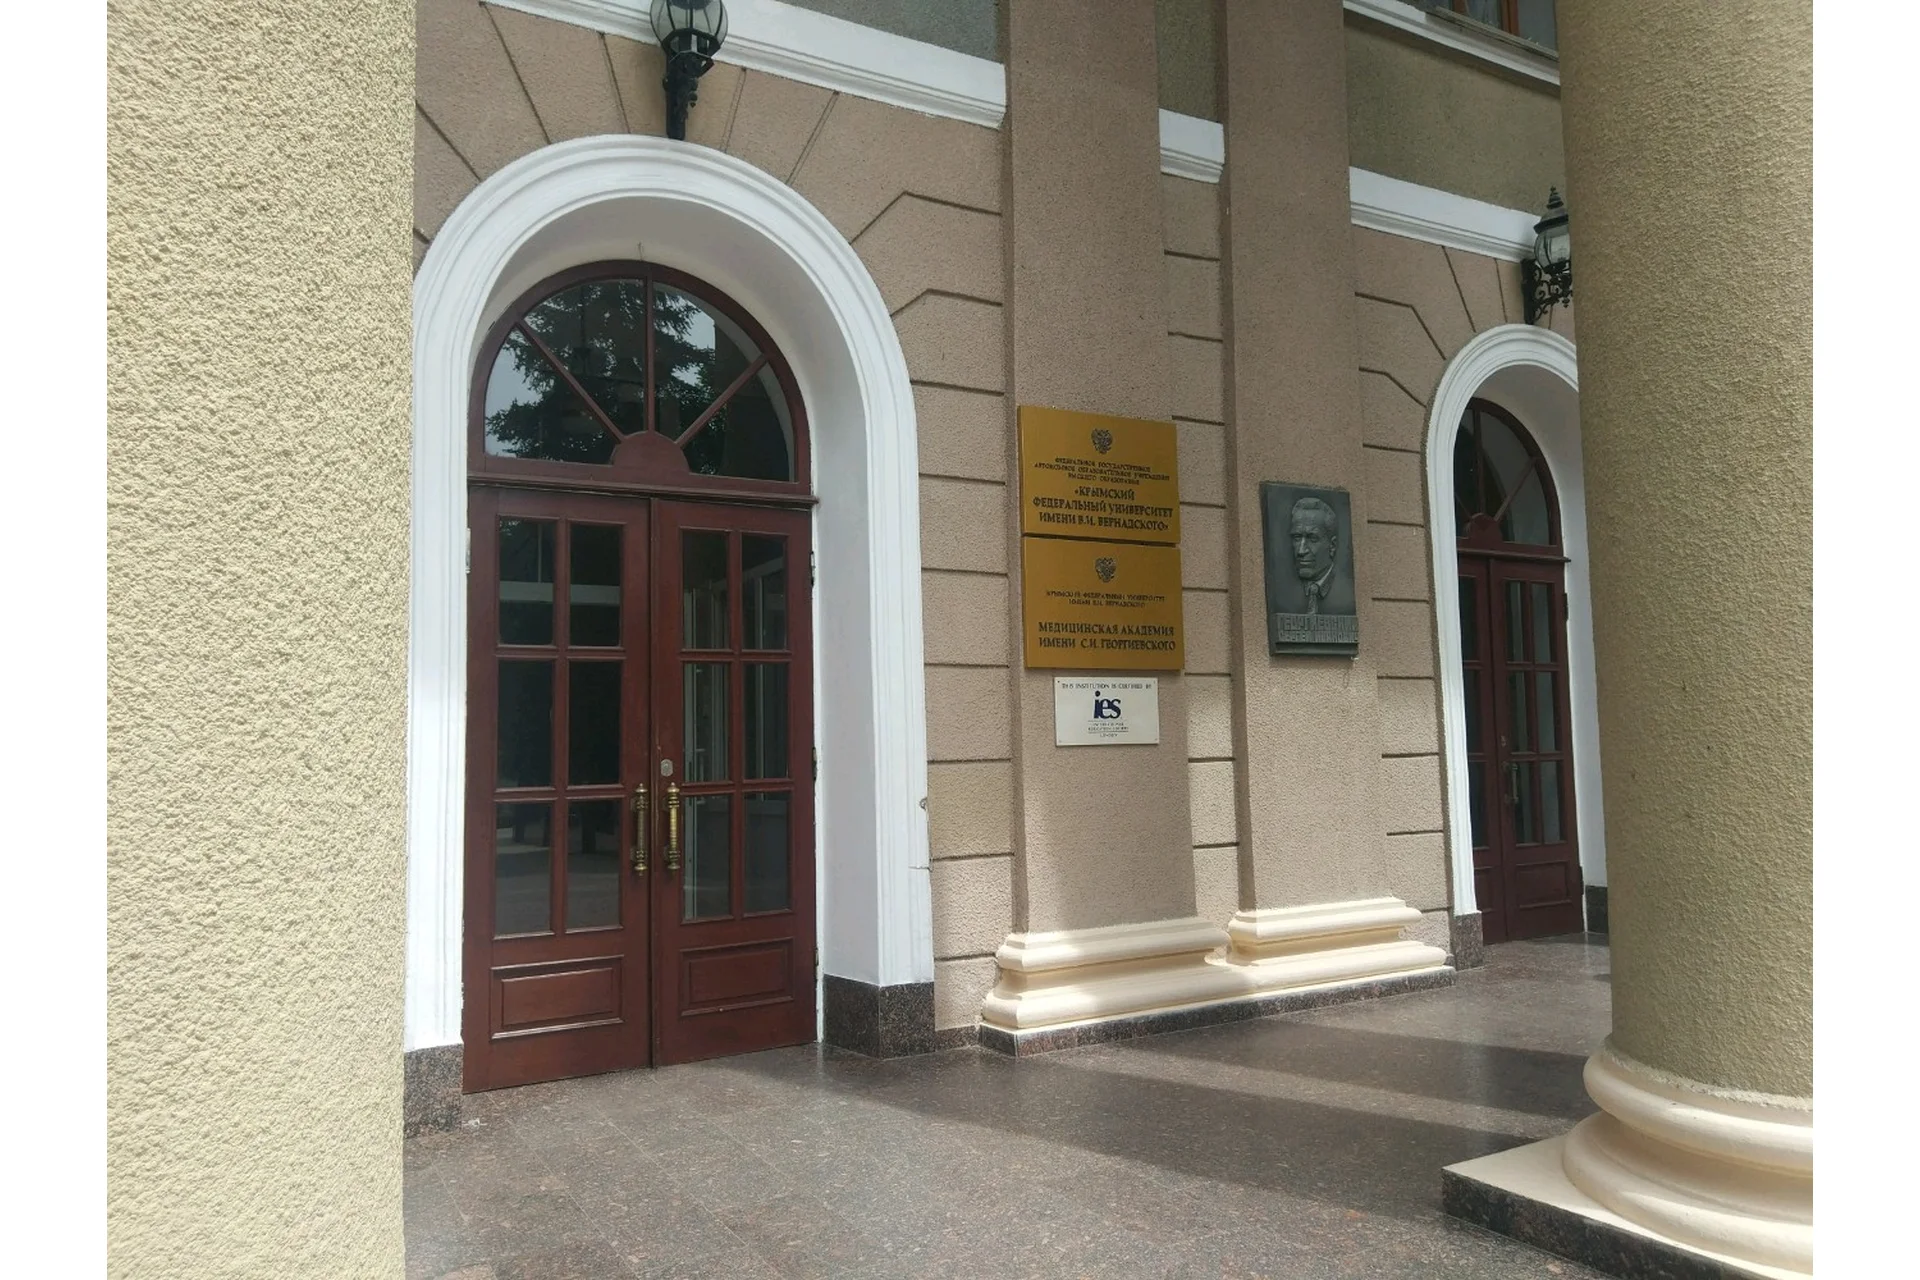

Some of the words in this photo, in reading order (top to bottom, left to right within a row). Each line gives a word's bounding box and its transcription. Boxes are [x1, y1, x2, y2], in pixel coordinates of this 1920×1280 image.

[1032, 496, 1106, 513] ФЕДЕРАЛЬНЫЙ
[1108, 504, 1173, 518] УНИВЕРСИТЕТ
[1039, 511, 1076, 524] ИМЕНИ
[1079, 516, 1095, 526] В.И.
[1038, 621, 1119, 635] МЕДИЦИНСКАЯ
[1121, 624, 1175, 637] АКАДЕМИЯ
[1039, 636, 1076, 649] ИМЕНИ
[1080, 638, 1099, 649] С.И.
[1101, 638, 1177, 651] ГЕОРГИЕВСКОГО
[1093, 690, 1121, 719] ies
